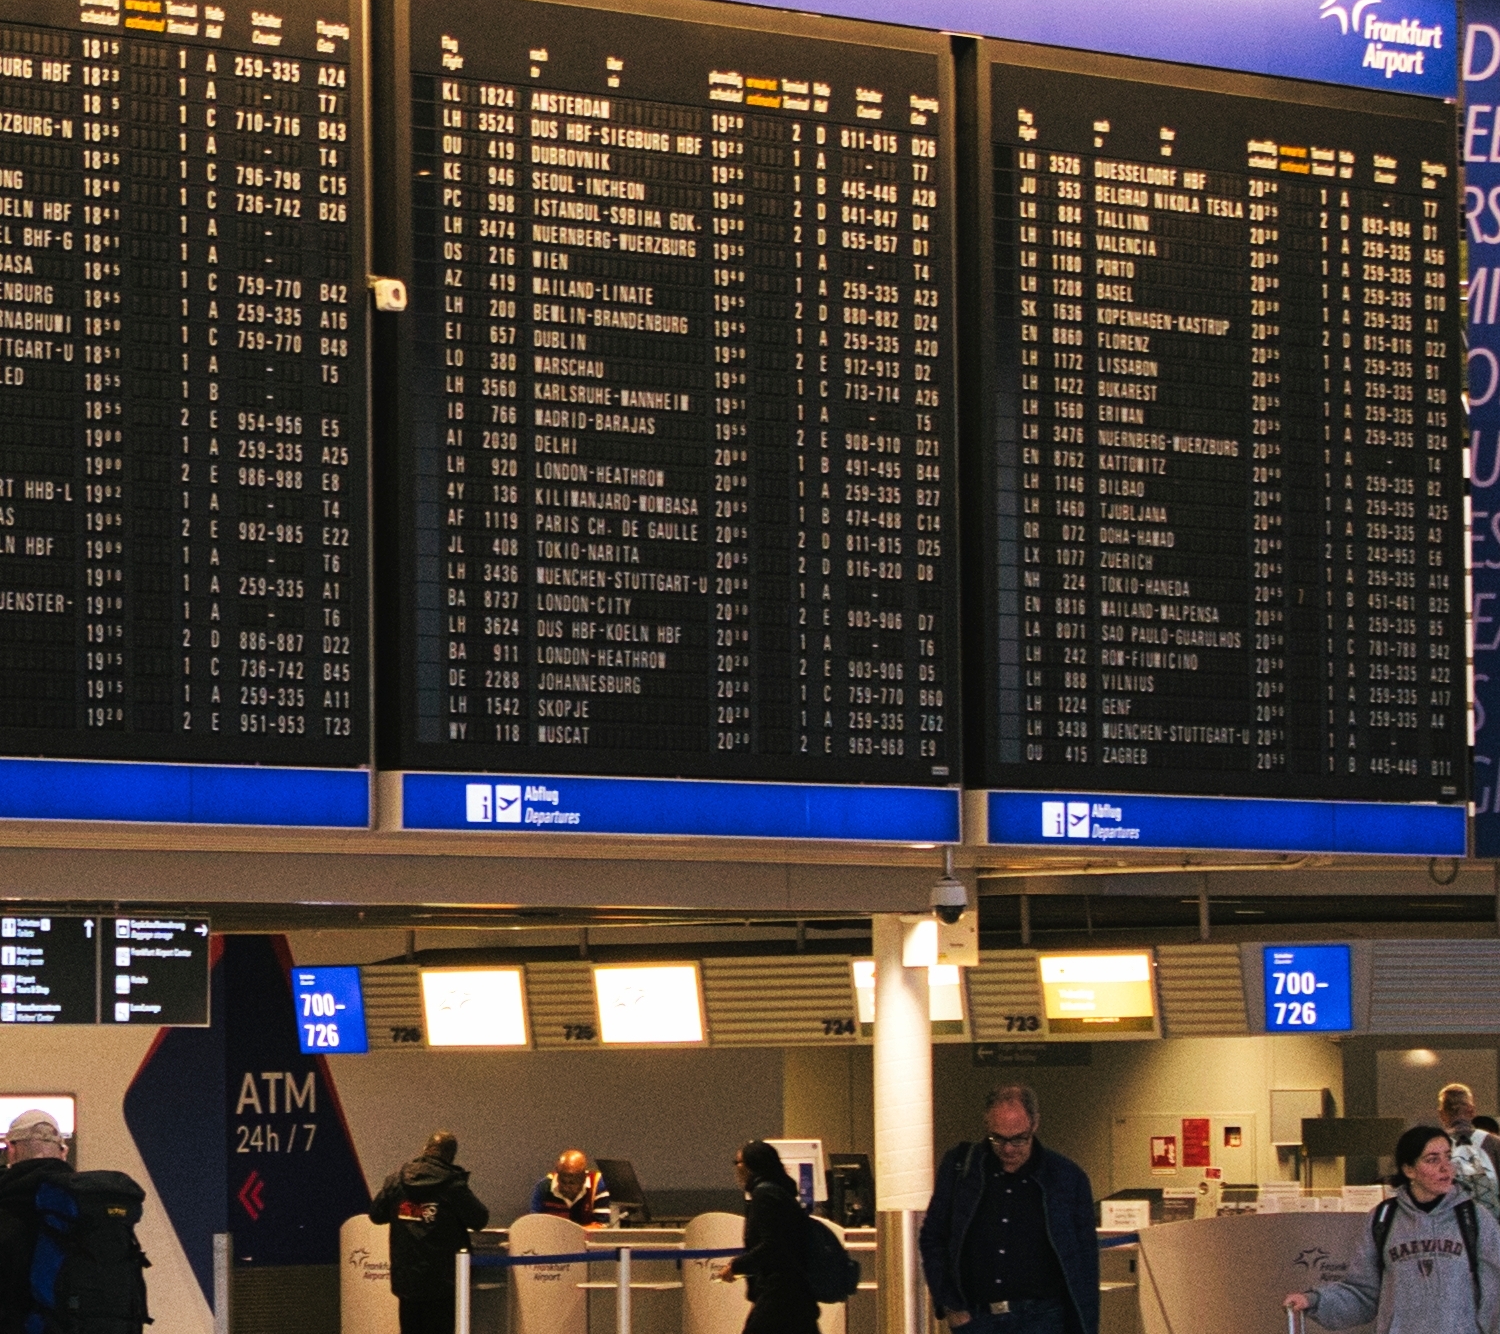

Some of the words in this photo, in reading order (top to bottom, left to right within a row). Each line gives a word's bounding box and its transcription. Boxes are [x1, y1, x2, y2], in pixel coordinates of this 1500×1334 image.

[1364, 13, 1443, 50] Frankfurt
[1362, 42, 1424, 79] Airport
[531, 93, 610, 119] AMSTERDAM
[531, 144, 610, 170] DUBROVNIK
[532, 171, 645, 201] SEOUL-INCHEON
[1095, 234, 1157, 256] VALENCIA
[1096, 258, 1135, 279] PORTO
[533, 329, 586, 351] DUBLIN
[538, 672, 641, 695] JOHANNESBURG
[1102, 674, 1155, 693] VILNIUS
[538, 698, 589, 719] SKOPJE
[1102, 746, 1148, 765] ZAGREB
[525, 786, 559, 805] Abflug
[525, 808, 581, 825] Departures
[1092, 804, 1122, 821] Abflug
[1092, 825, 1140, 839] Departures
[1004, 1015, 1040, 1032] 723
[1274, 1002, 1316, 1025] 726
[307, 1024, 339, 1046] 726
[822, 1019, 855, 1036] 724
[235, 1072, 316, 1114] ATM
[236, 1125, 280, 1153] 24h
[303, 1126, 316, 1152] 7
[1389, 1238, 1464, 1261] HARVARD
